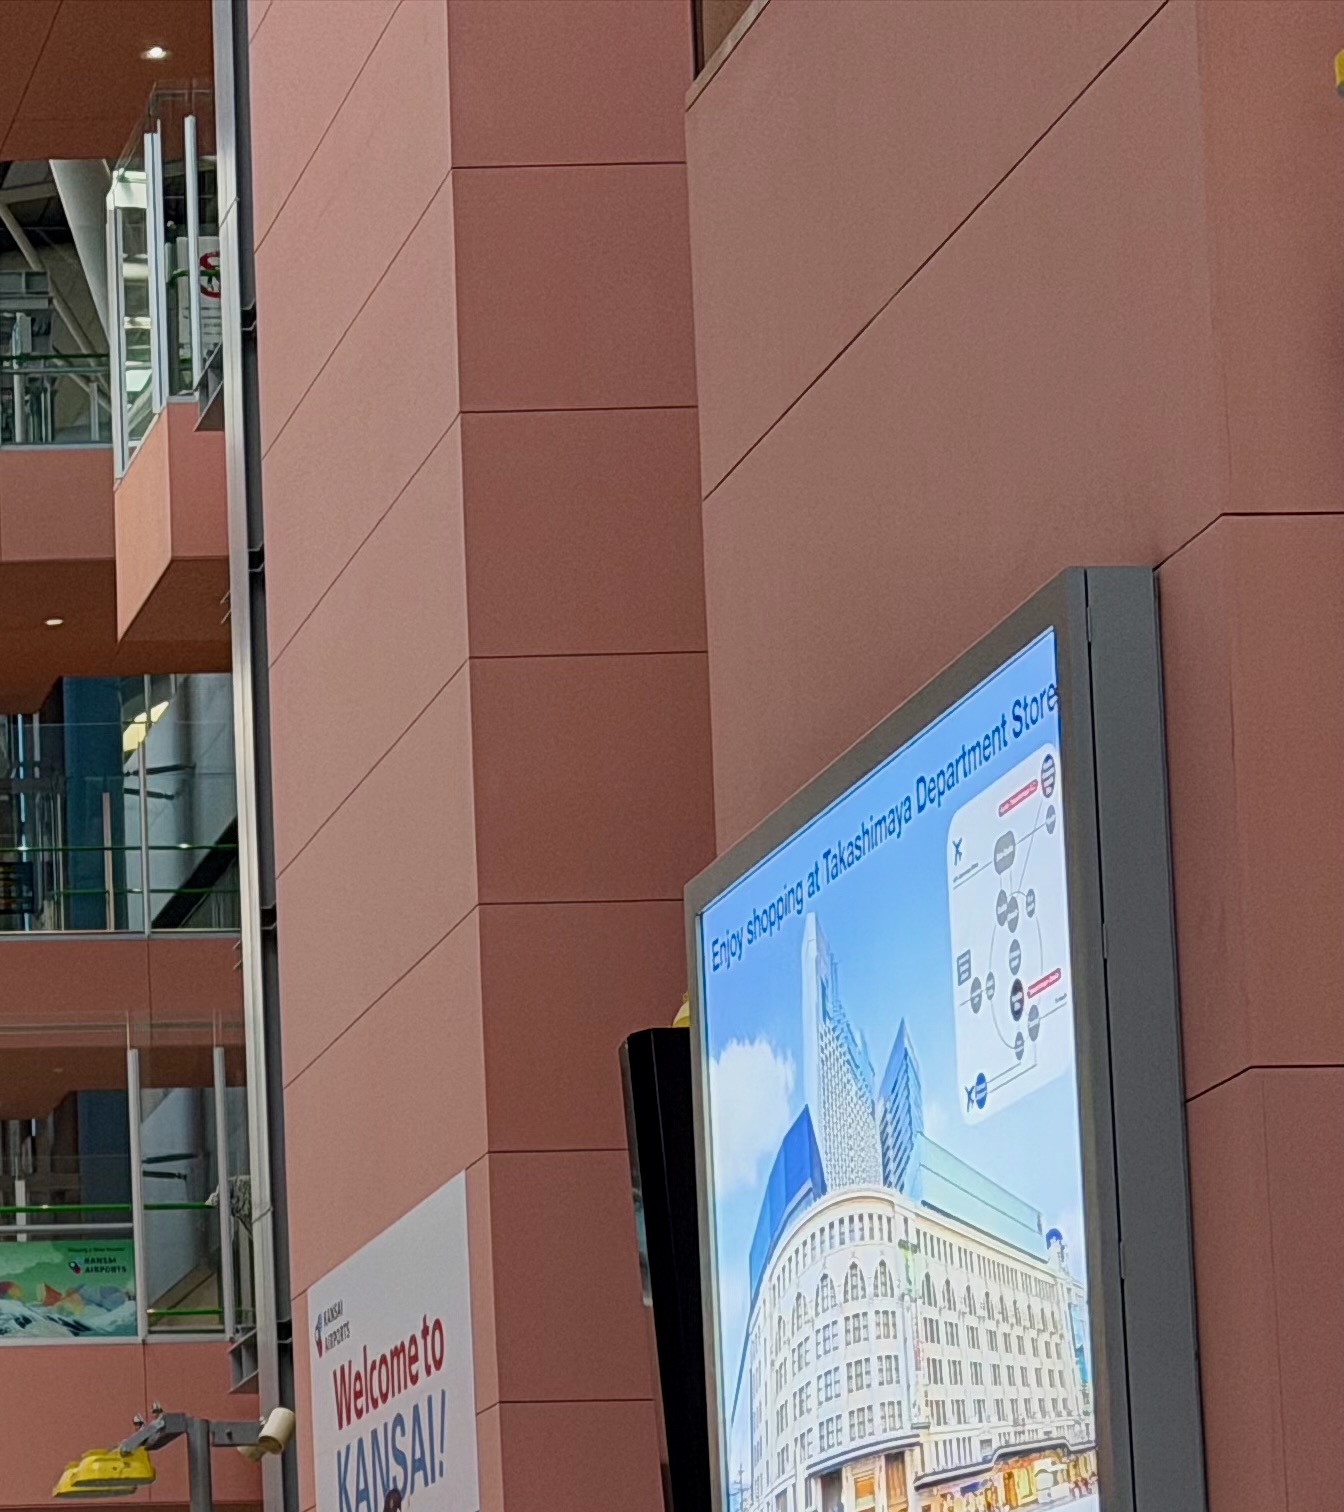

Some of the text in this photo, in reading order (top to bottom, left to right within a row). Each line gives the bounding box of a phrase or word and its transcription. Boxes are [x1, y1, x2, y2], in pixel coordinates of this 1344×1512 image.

[711, 682, 1057, 972] Enjoy shopping at Takashimaya Department Store
[323, 1299, 344, 1327] KANSAI
[324, 1320, 351, 1352] AIRPORTS
[332, 1314, 445, 1431] Welcome to
